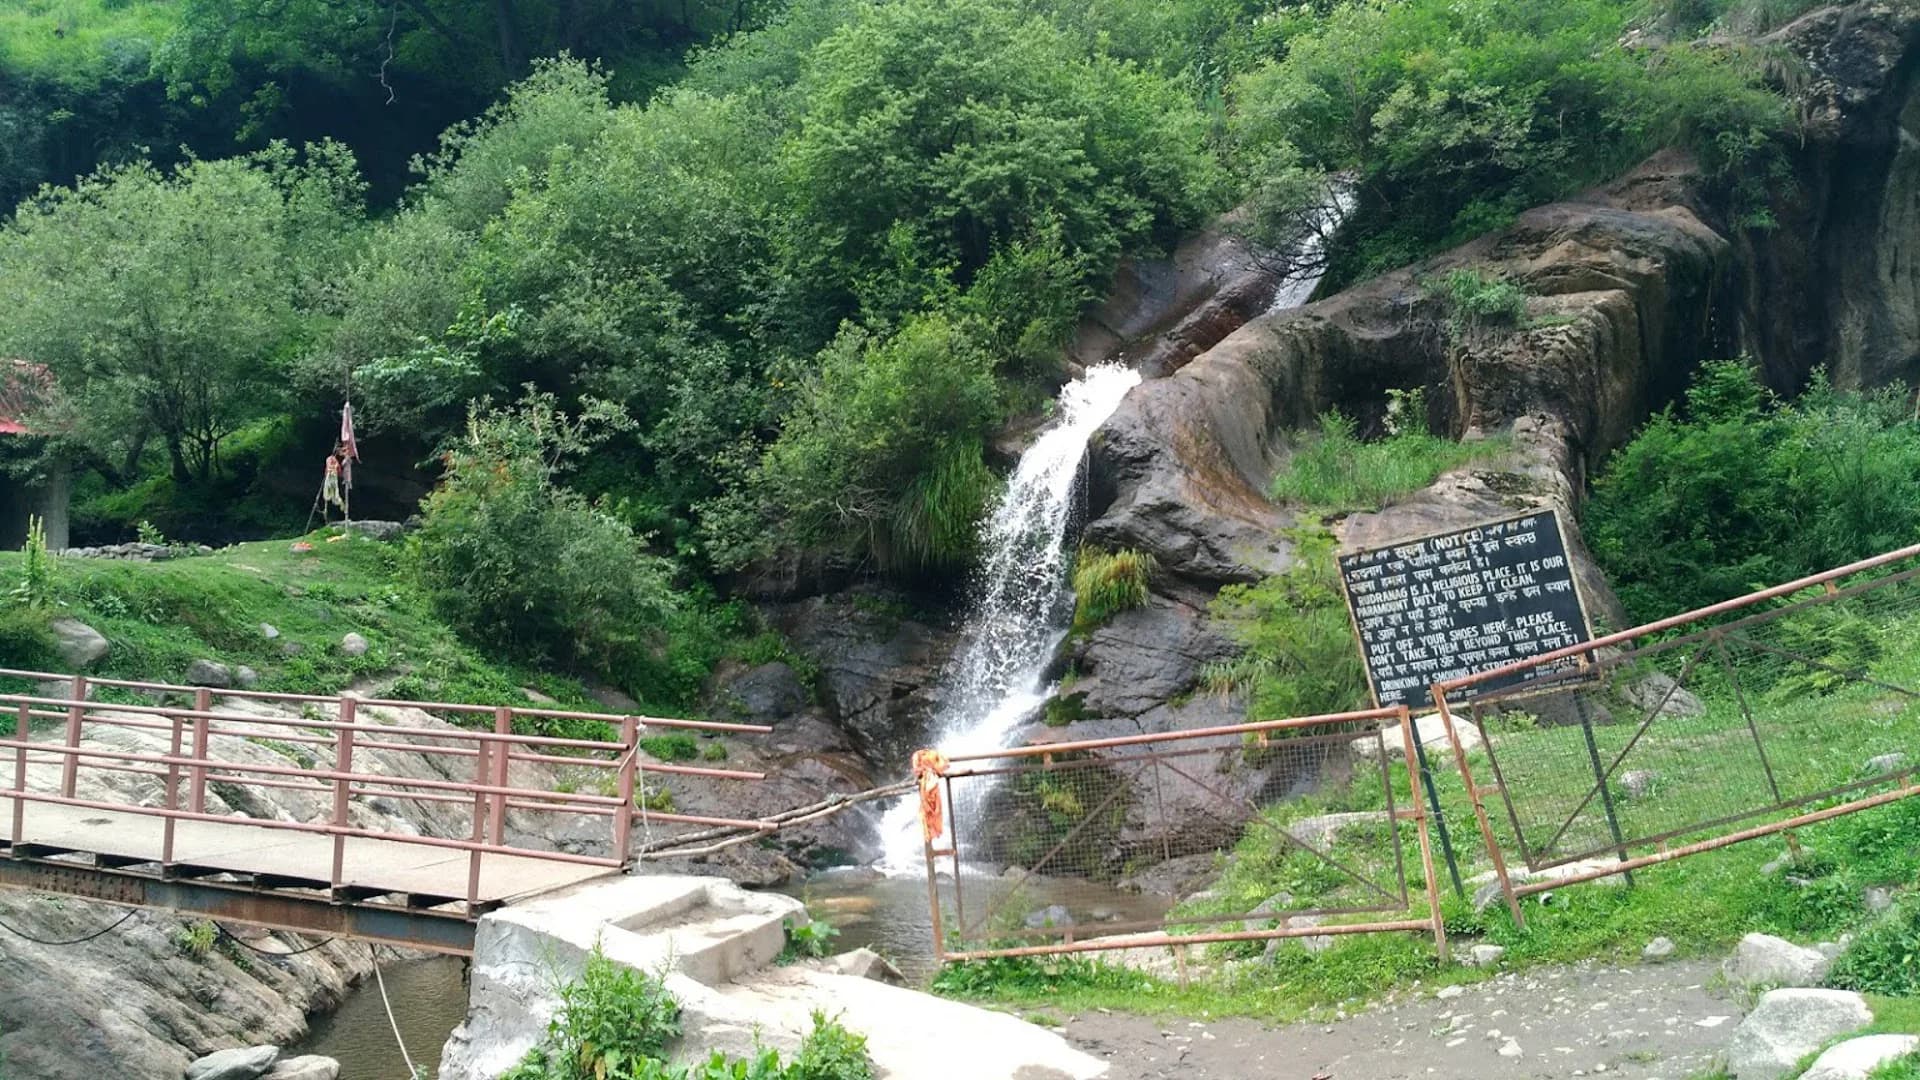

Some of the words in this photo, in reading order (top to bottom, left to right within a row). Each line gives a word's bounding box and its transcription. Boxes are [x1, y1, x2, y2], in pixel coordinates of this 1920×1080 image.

[1430, 528, 1483, 551] (NOTICE)
[1504, 532, 1536, 546] स्वच्छ
[1356, 598, 1408, 617] PARAMOUNT
[1412, 592, 1436, 607] DUTY
[1442, 589, 1455, 601] TO
[1458, 584, 1483, 598] KEEP
[1486, 581, 1496, 592] IT
[1500, 574, 1535, 589] CLEAN.
[1358, 587, 1407, 605] RUDRANAG
[1410, 584, 1419, 596] IS
[1422, 583, 1429, 594] A
[1432, 572, 1479, 592] RELIGIOUS
[1482, 566, 1514, 581] PLACE.
[1516, 563, 1525, 574] IT
[1530, 560, 1540, 572] IS
[1542, 555, 1563, 569] OUR
[1370, 642, 1390, 655] PUT
[1395, 638, 1413, 651] OFF
[1419, 632, 1446, 646] YOUR
[1449, 626, 1478, 641] SHOES
[1516, 611, 1554, 628] PLEASE
[1400, 647, 1427, 661] TAKE
[1431, 641, 1458, 655] THEM
[1463, 634, 1500, 649] BEYOND
[1506, 628, 1529, 641] THIS
[1535, 621, 1571, 636] PLACE.
[1401, 625, 1409, 635] न
[1381, 676, 1419, 693] DRINKING
[1422, 674, 1430, 685] &
[1432, 667, 1469, 683] SMOKING
[1471, 665, 1480, 673] IS
